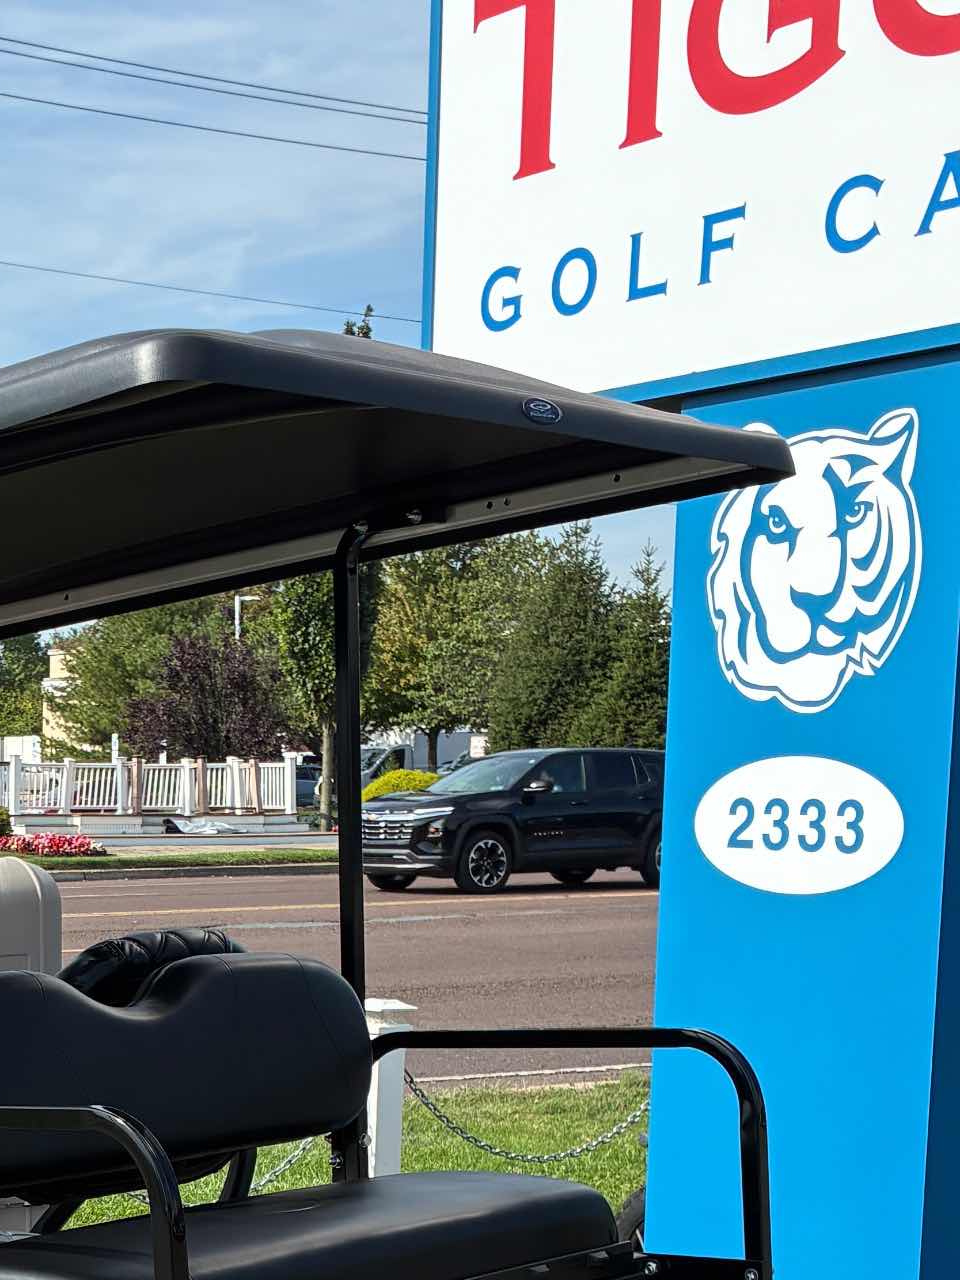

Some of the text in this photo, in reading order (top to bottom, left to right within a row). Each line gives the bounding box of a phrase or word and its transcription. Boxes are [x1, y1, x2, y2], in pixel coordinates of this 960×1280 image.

[473, 0, 960, 181] TIG
[481, 202, 746, 332] GOLF
[727, 797, 864, 854] 2333
